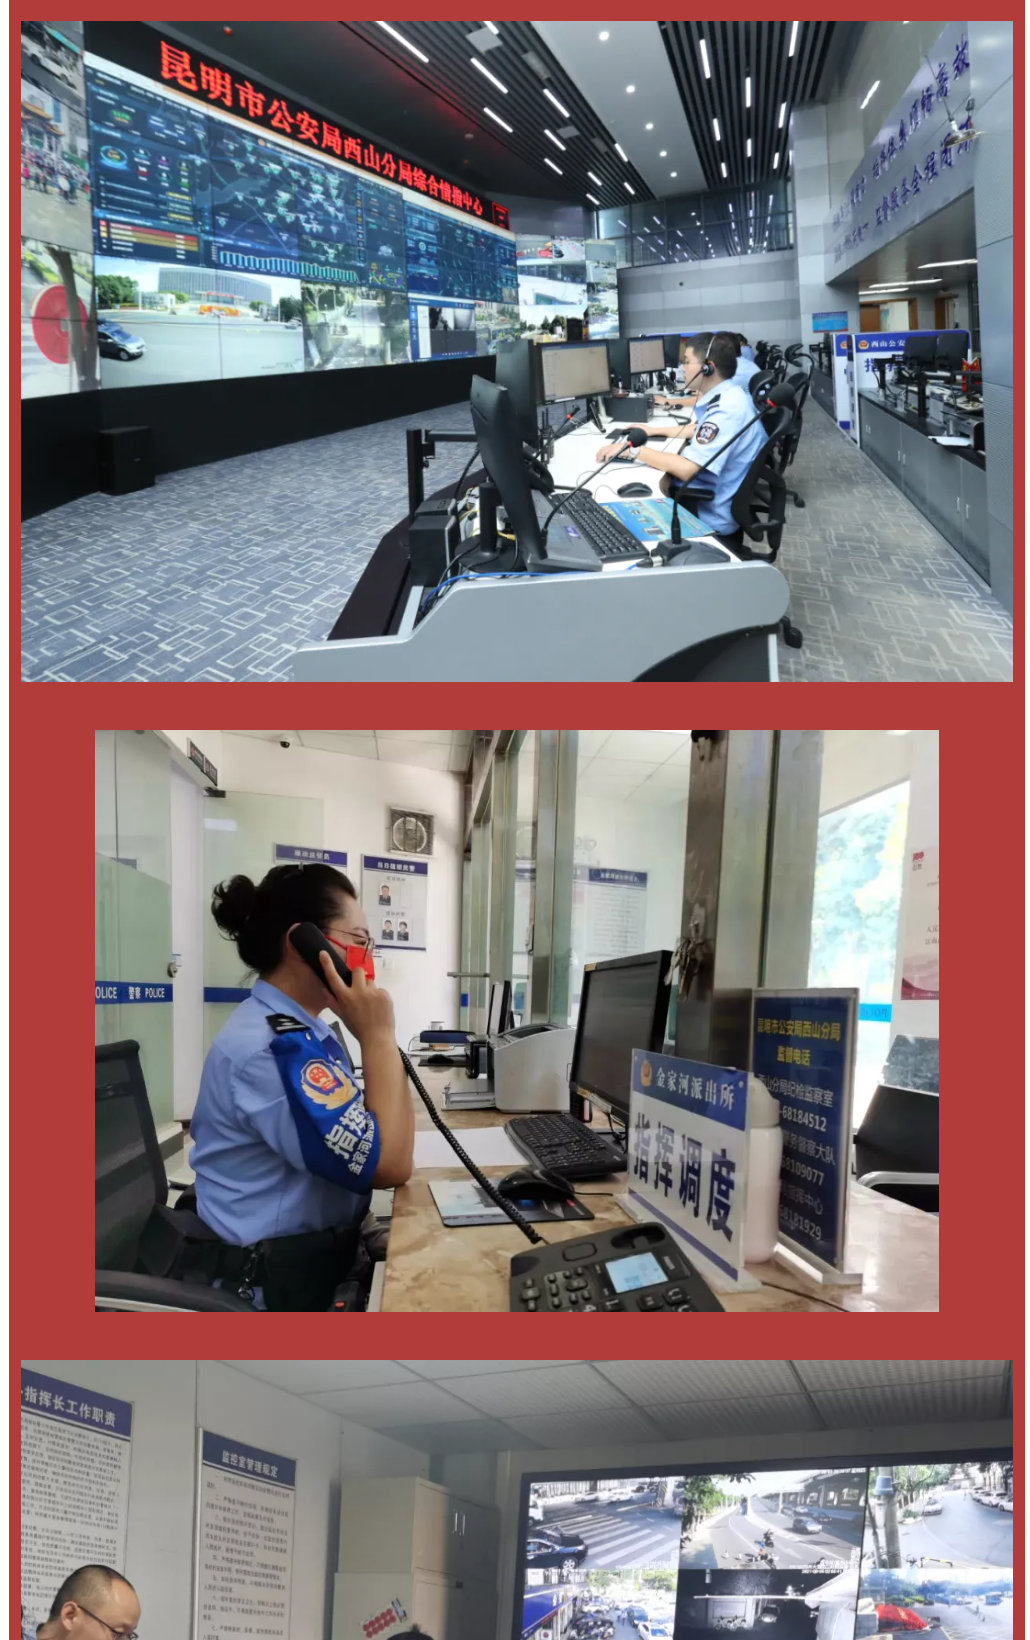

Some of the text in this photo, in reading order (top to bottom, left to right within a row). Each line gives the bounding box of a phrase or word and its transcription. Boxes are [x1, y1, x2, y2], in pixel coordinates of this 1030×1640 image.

[160, 40, 484, 216] 昆明市公安局西山分局综合情指中心
[129, 986, 165, 999] 警察 POLICE
[757, 1018, 841, 1042] 昆明市公安局西山分局
[776, 1045, 811, 1067] 监督电话
[656, 1066, 735, 1111] 金家河派出所
[634, 1111, 736, 1243] 指挥调度
[25, 1385, 116, 1428] 指挥长工作职责
